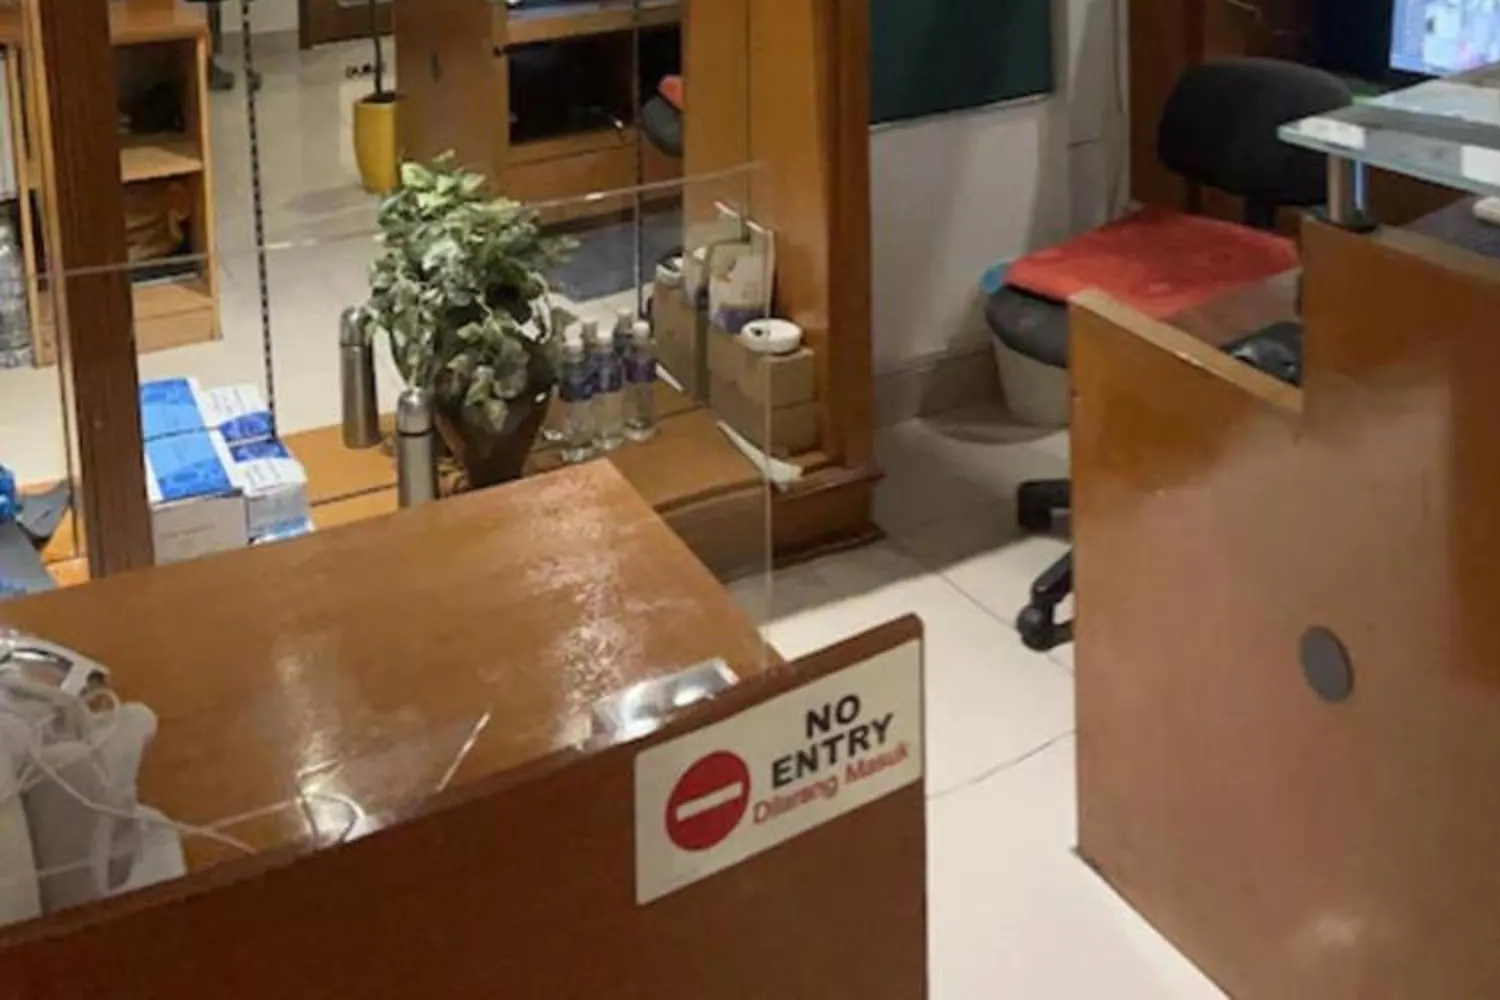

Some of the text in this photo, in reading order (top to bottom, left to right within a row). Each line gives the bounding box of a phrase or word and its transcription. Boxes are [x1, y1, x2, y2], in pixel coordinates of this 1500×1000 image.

[806, 694, 861, 739] NO
[772, 712, 894, 789] ENTRY
[753, 774, 838, 825] Dilarang
